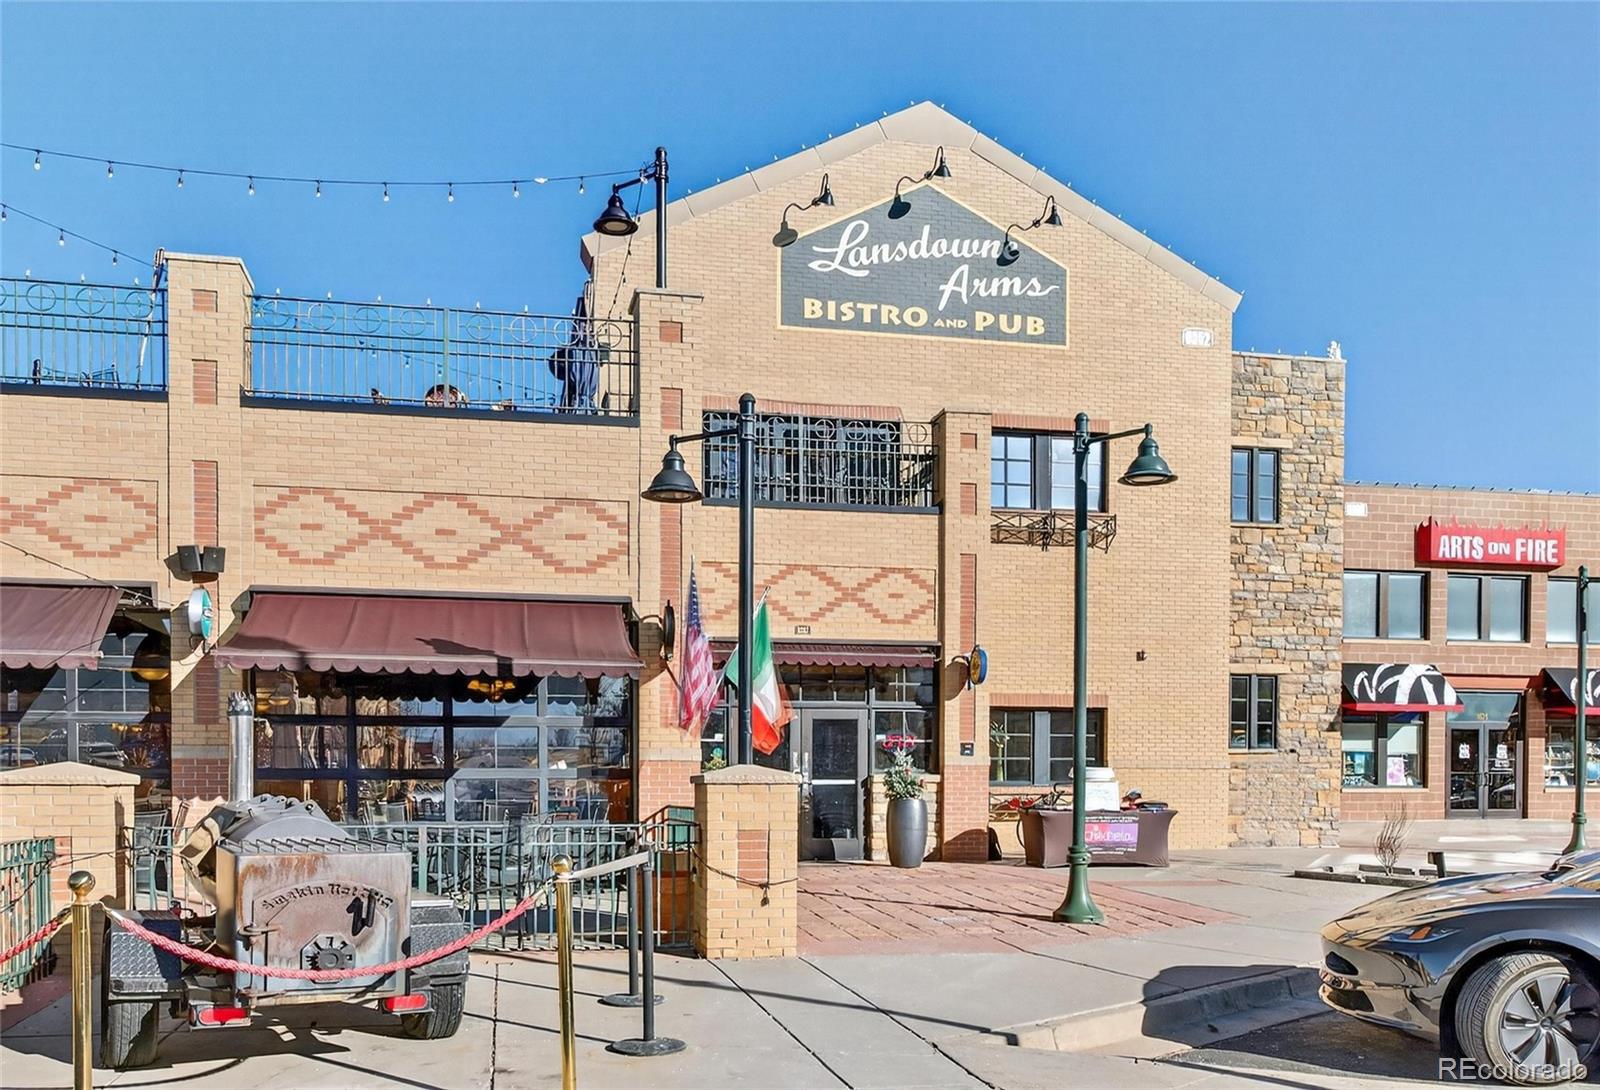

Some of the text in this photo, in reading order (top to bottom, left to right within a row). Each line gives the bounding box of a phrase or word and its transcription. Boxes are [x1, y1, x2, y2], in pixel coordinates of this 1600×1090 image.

[938, 264, 1060, 311] Arms
[803, 298, 1045, 336] BISTRO AND PUB
[1438, 535, 1558, 563] ARTS ON FIRE
